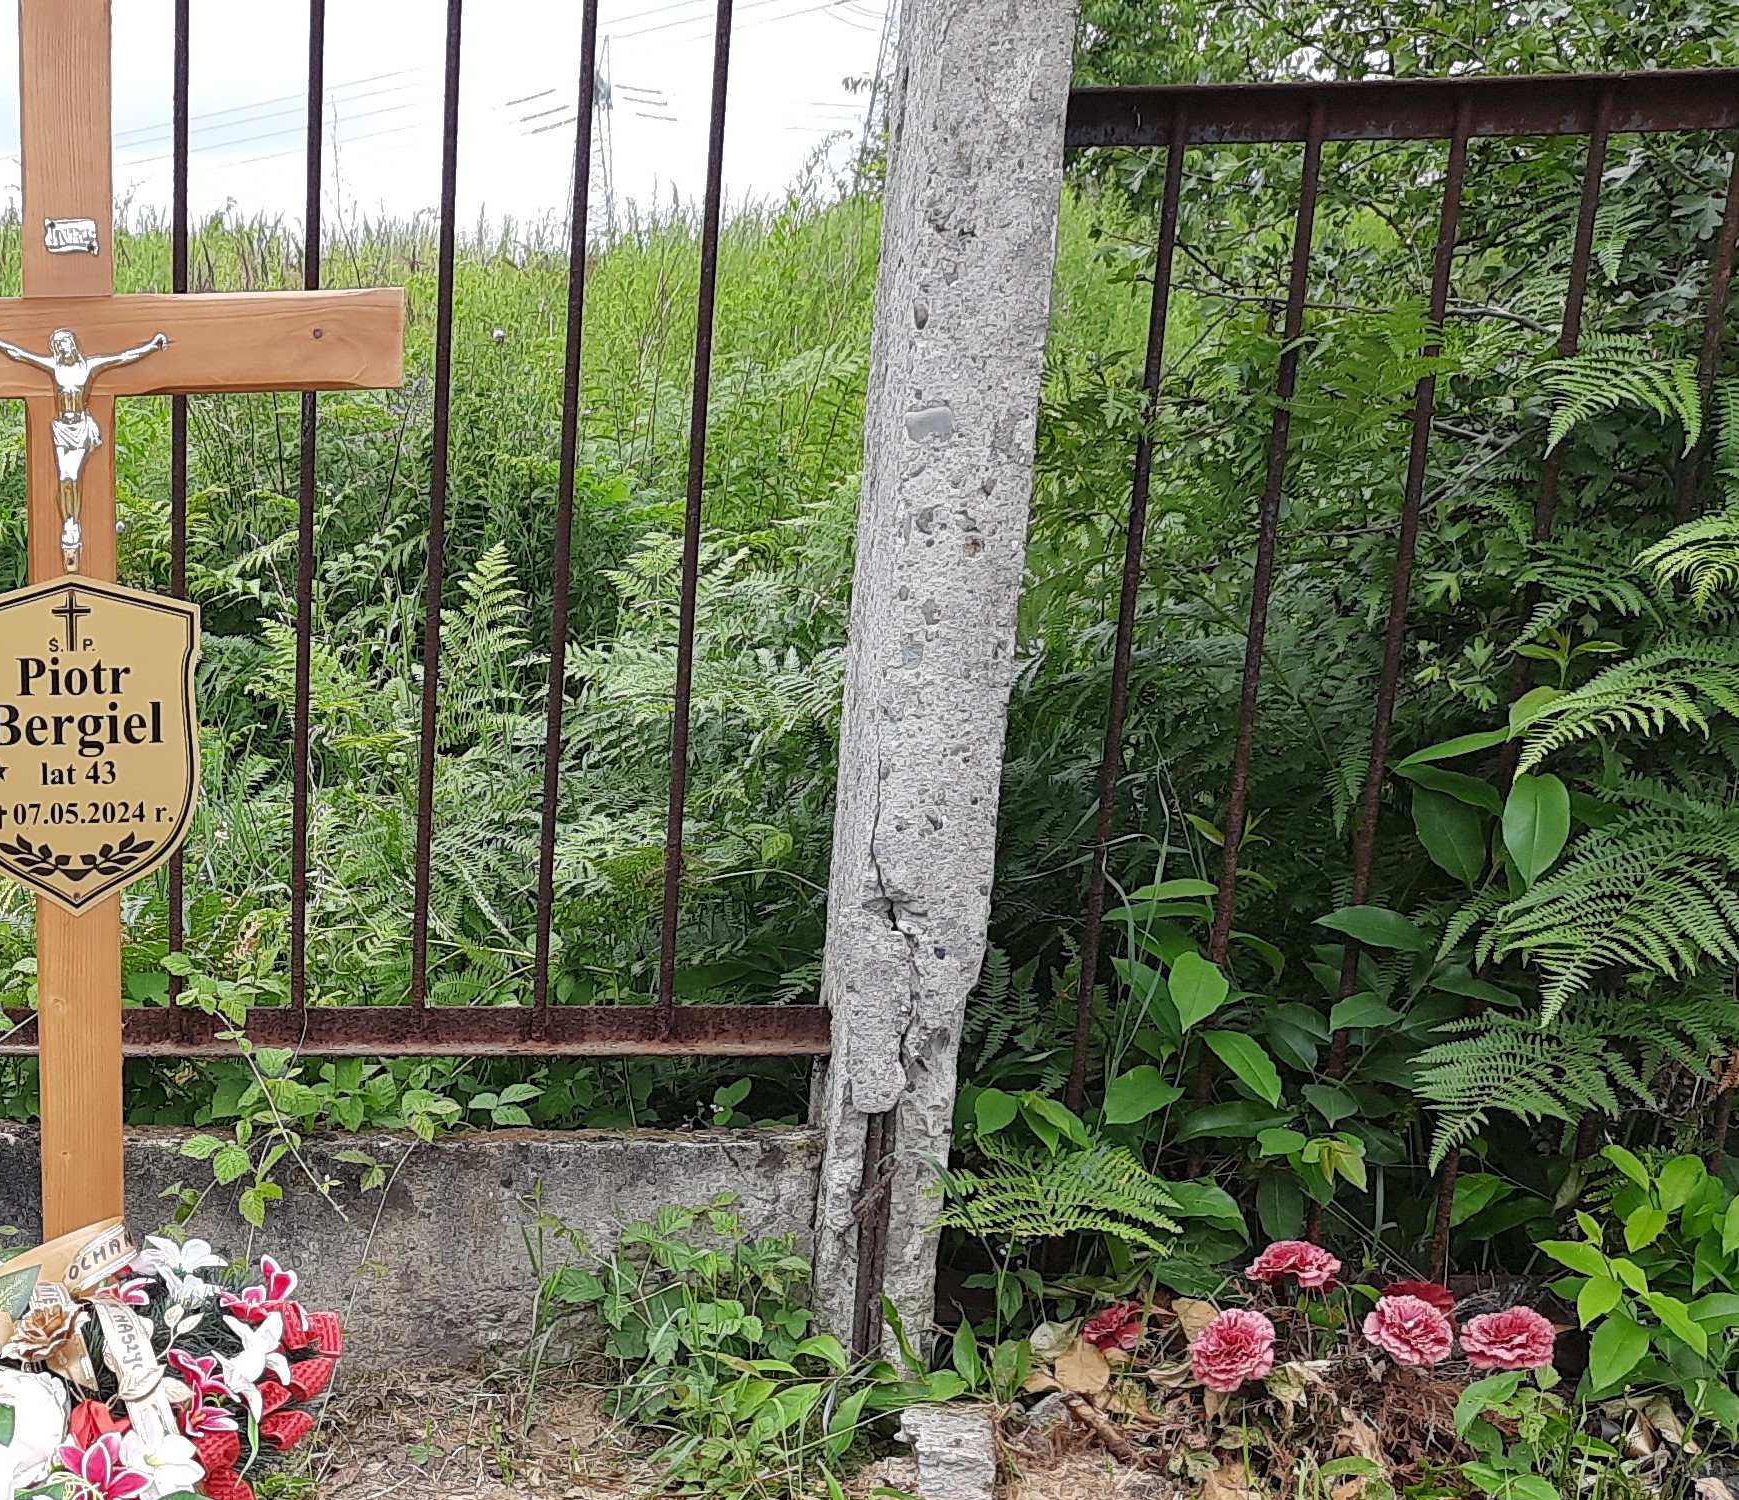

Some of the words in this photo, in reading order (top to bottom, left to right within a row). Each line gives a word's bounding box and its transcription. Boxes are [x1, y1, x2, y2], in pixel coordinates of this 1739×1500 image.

[82, 638, 96, 652] P.
[16, 656, 131, 697] Piotr
[40, 762, 77, 786] lat
[85, 760, 117, 785] 43
[13, 801, 146, 825] 07.05.2024
[155, 804, 174, 823] r.
